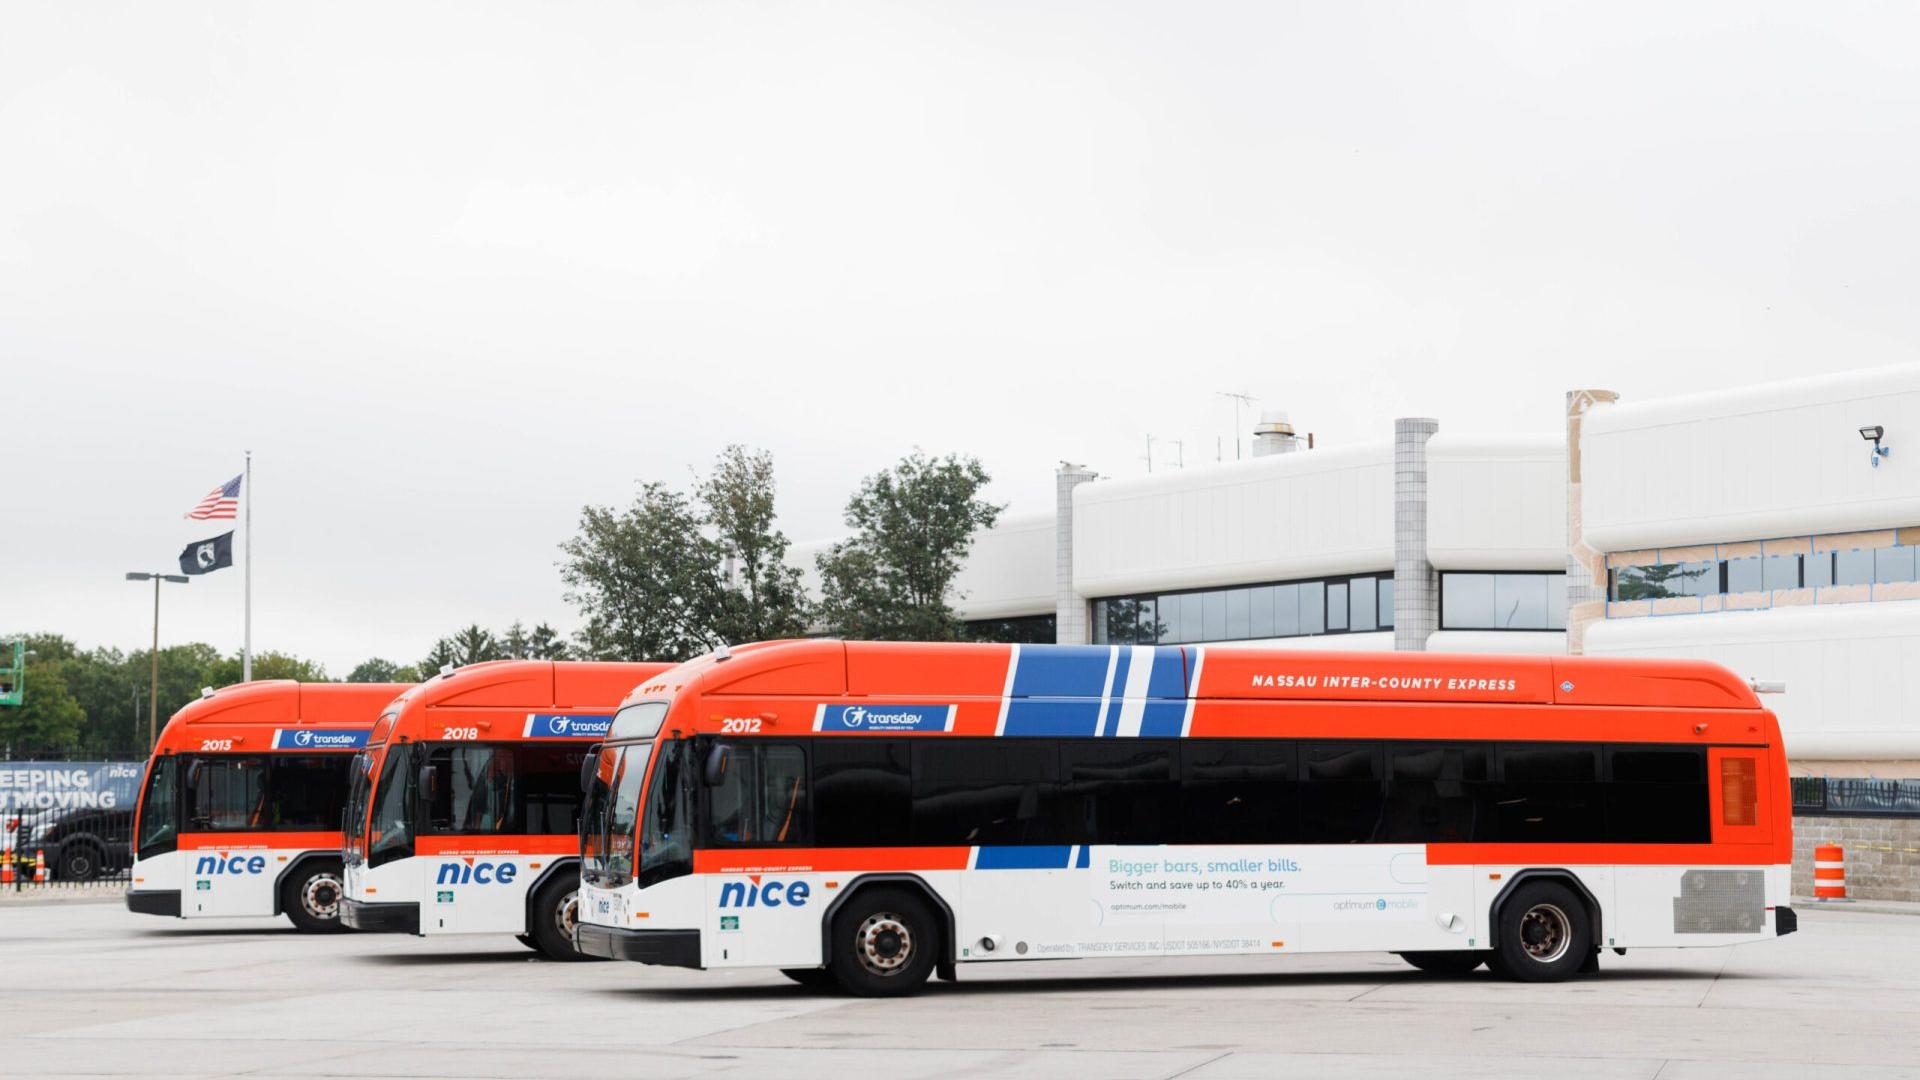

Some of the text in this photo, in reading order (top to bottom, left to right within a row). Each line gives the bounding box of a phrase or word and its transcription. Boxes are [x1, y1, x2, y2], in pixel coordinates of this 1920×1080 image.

[1252, 675, 1516, 691] NASSAU INTER-COUNTY EXPRESS
[867, 712, 922, 724] transdev
[721, 718, 762, 733] 2012
[314, 734, 356, 744] transdev
[442, 727, 478, 740] 2018
[201, 739, 232, 751] 2013
[109, 766, 138, 778] nice
[13, 791, 116, 809] MOVING
[196, 851, 266, 875] nice
[1109, 858, 1301, 876] Bigger bars, smaller bills.
[437, 857, 517, 884] nice
[719, 875, 810, 907] nice
[1110, 879, 1285, 892] Switch and save up to 40% a year.
[1111, 902, 1187, 912] optimum.com/mobile
[1333, 898, 1418, 911] optimum mobile
